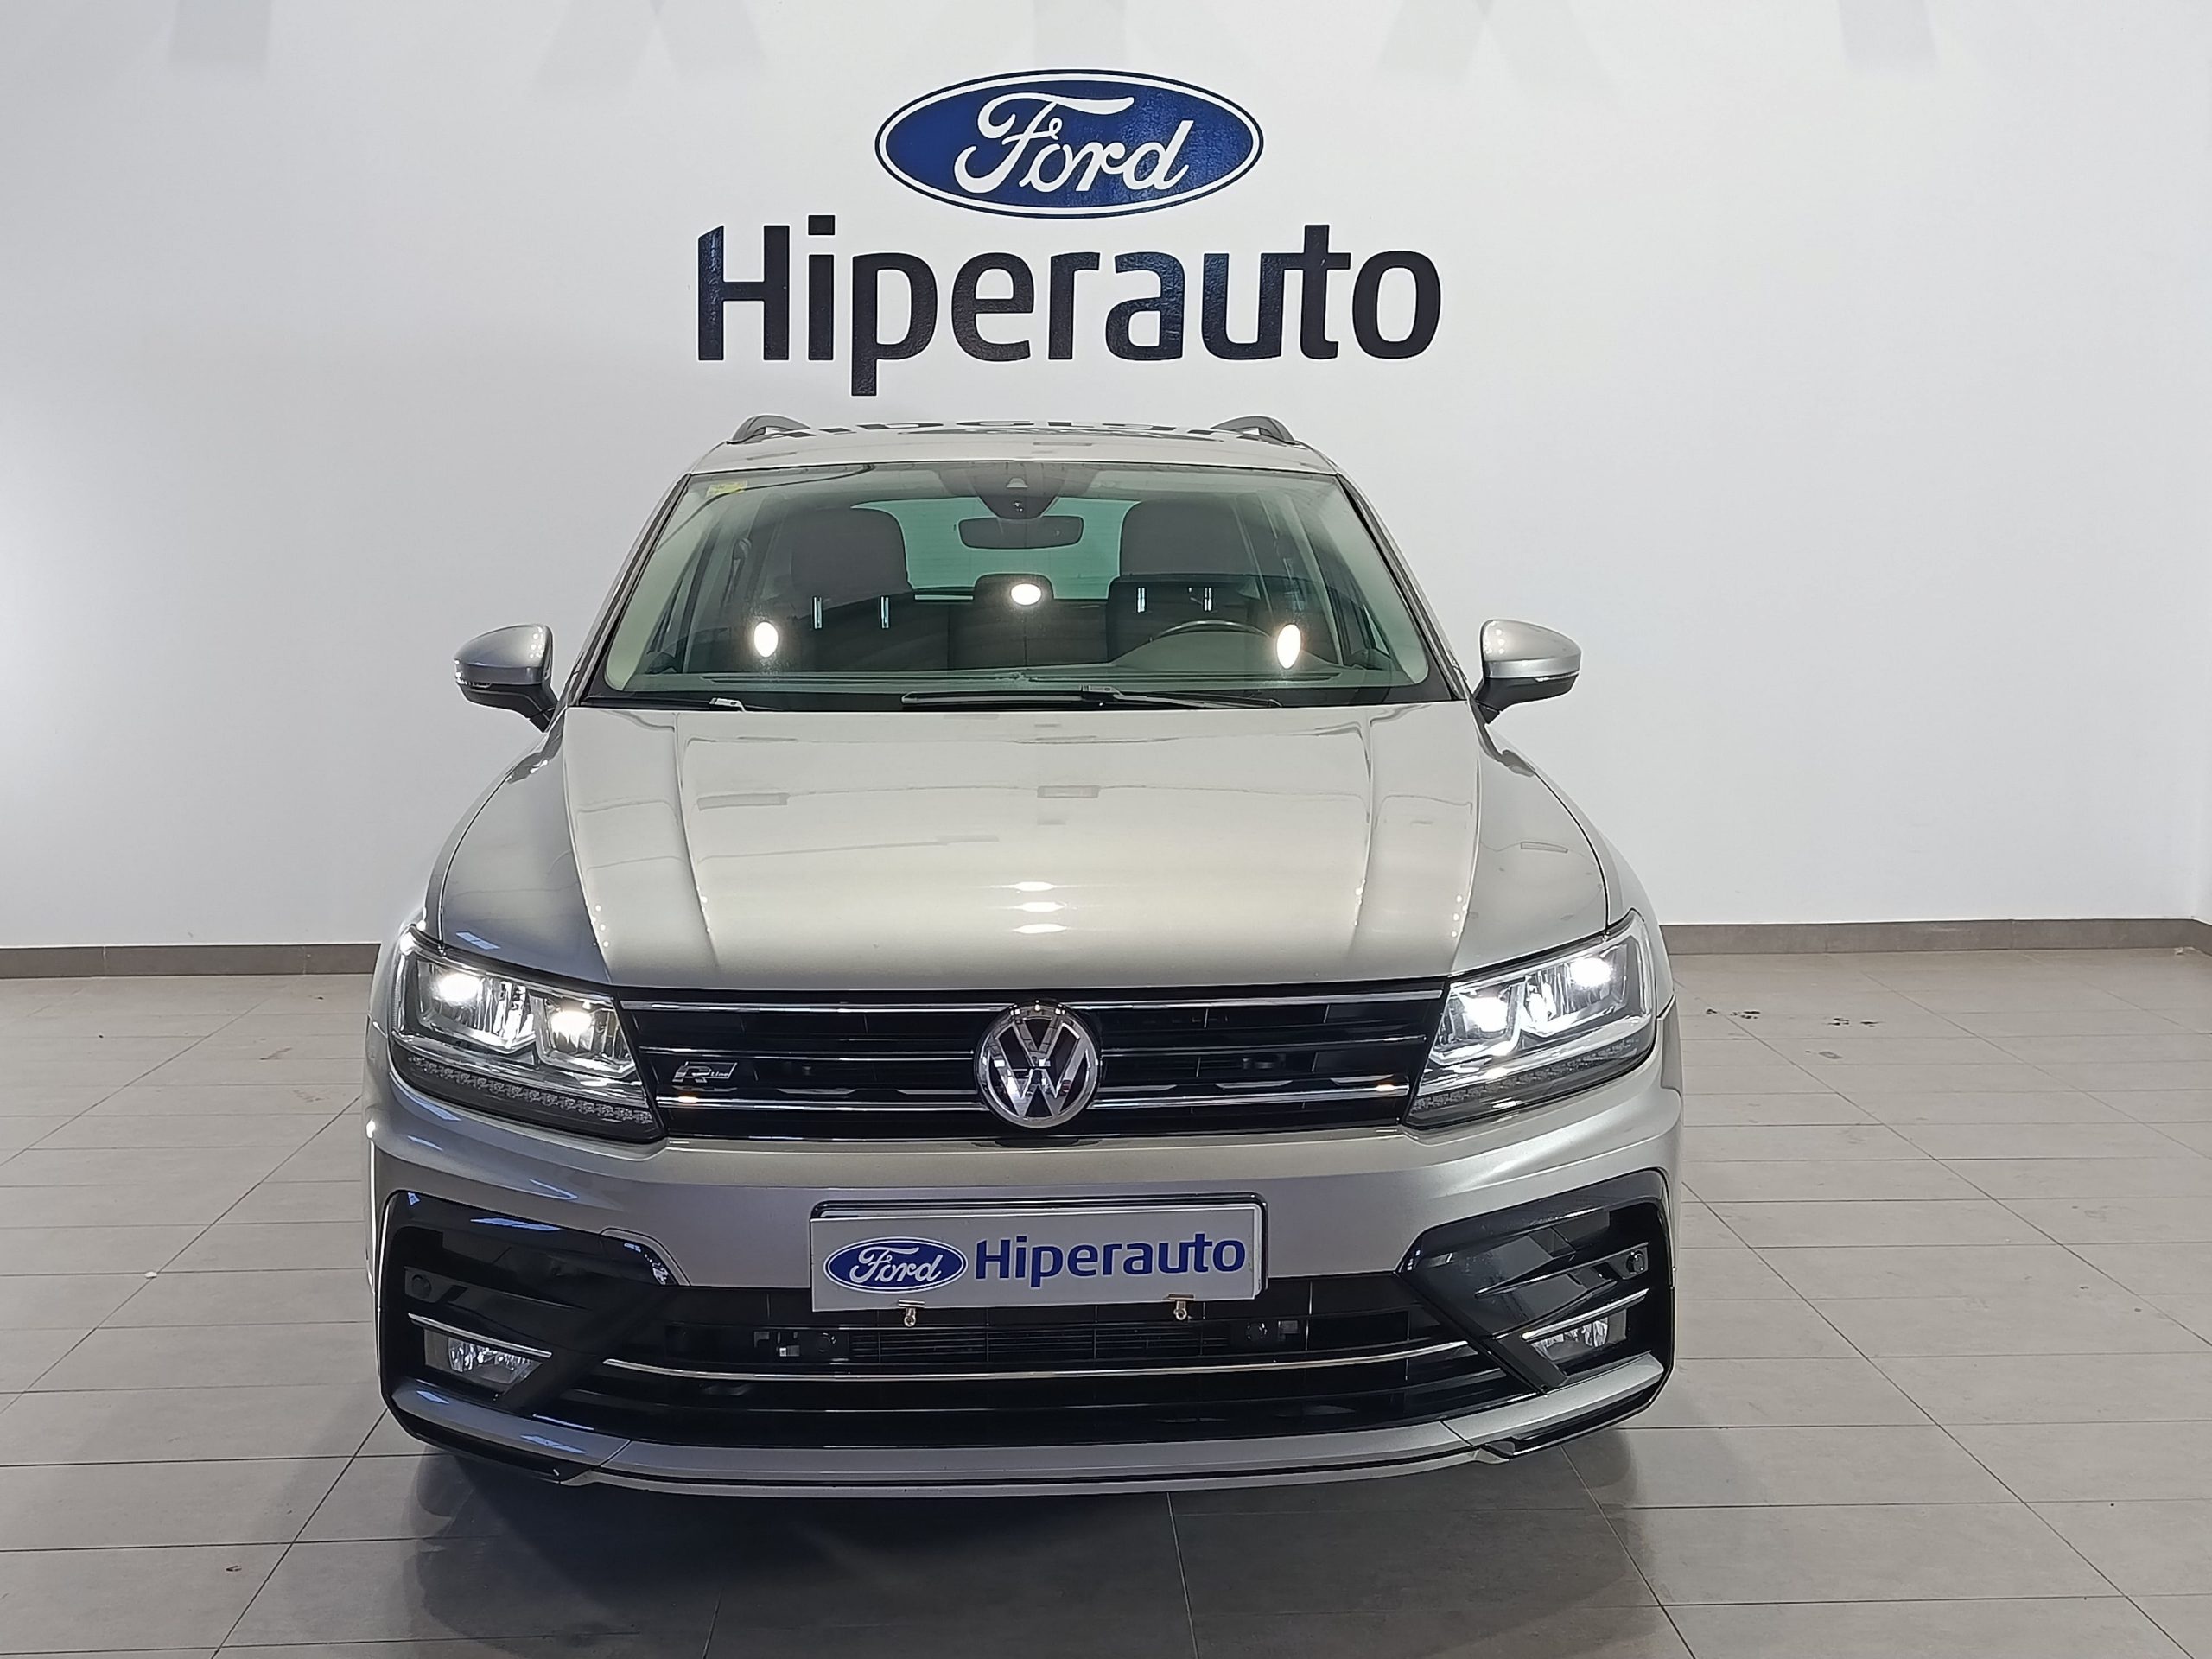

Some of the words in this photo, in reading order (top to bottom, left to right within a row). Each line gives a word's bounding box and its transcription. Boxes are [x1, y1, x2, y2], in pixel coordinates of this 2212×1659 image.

[954, 92, 1194, 193] Ford
[697, 215, 1441, 396] Hiperauto
[849, 1246, 944, 1283] Ford
[975, 1233, 1246, 1288] Hiperauto
